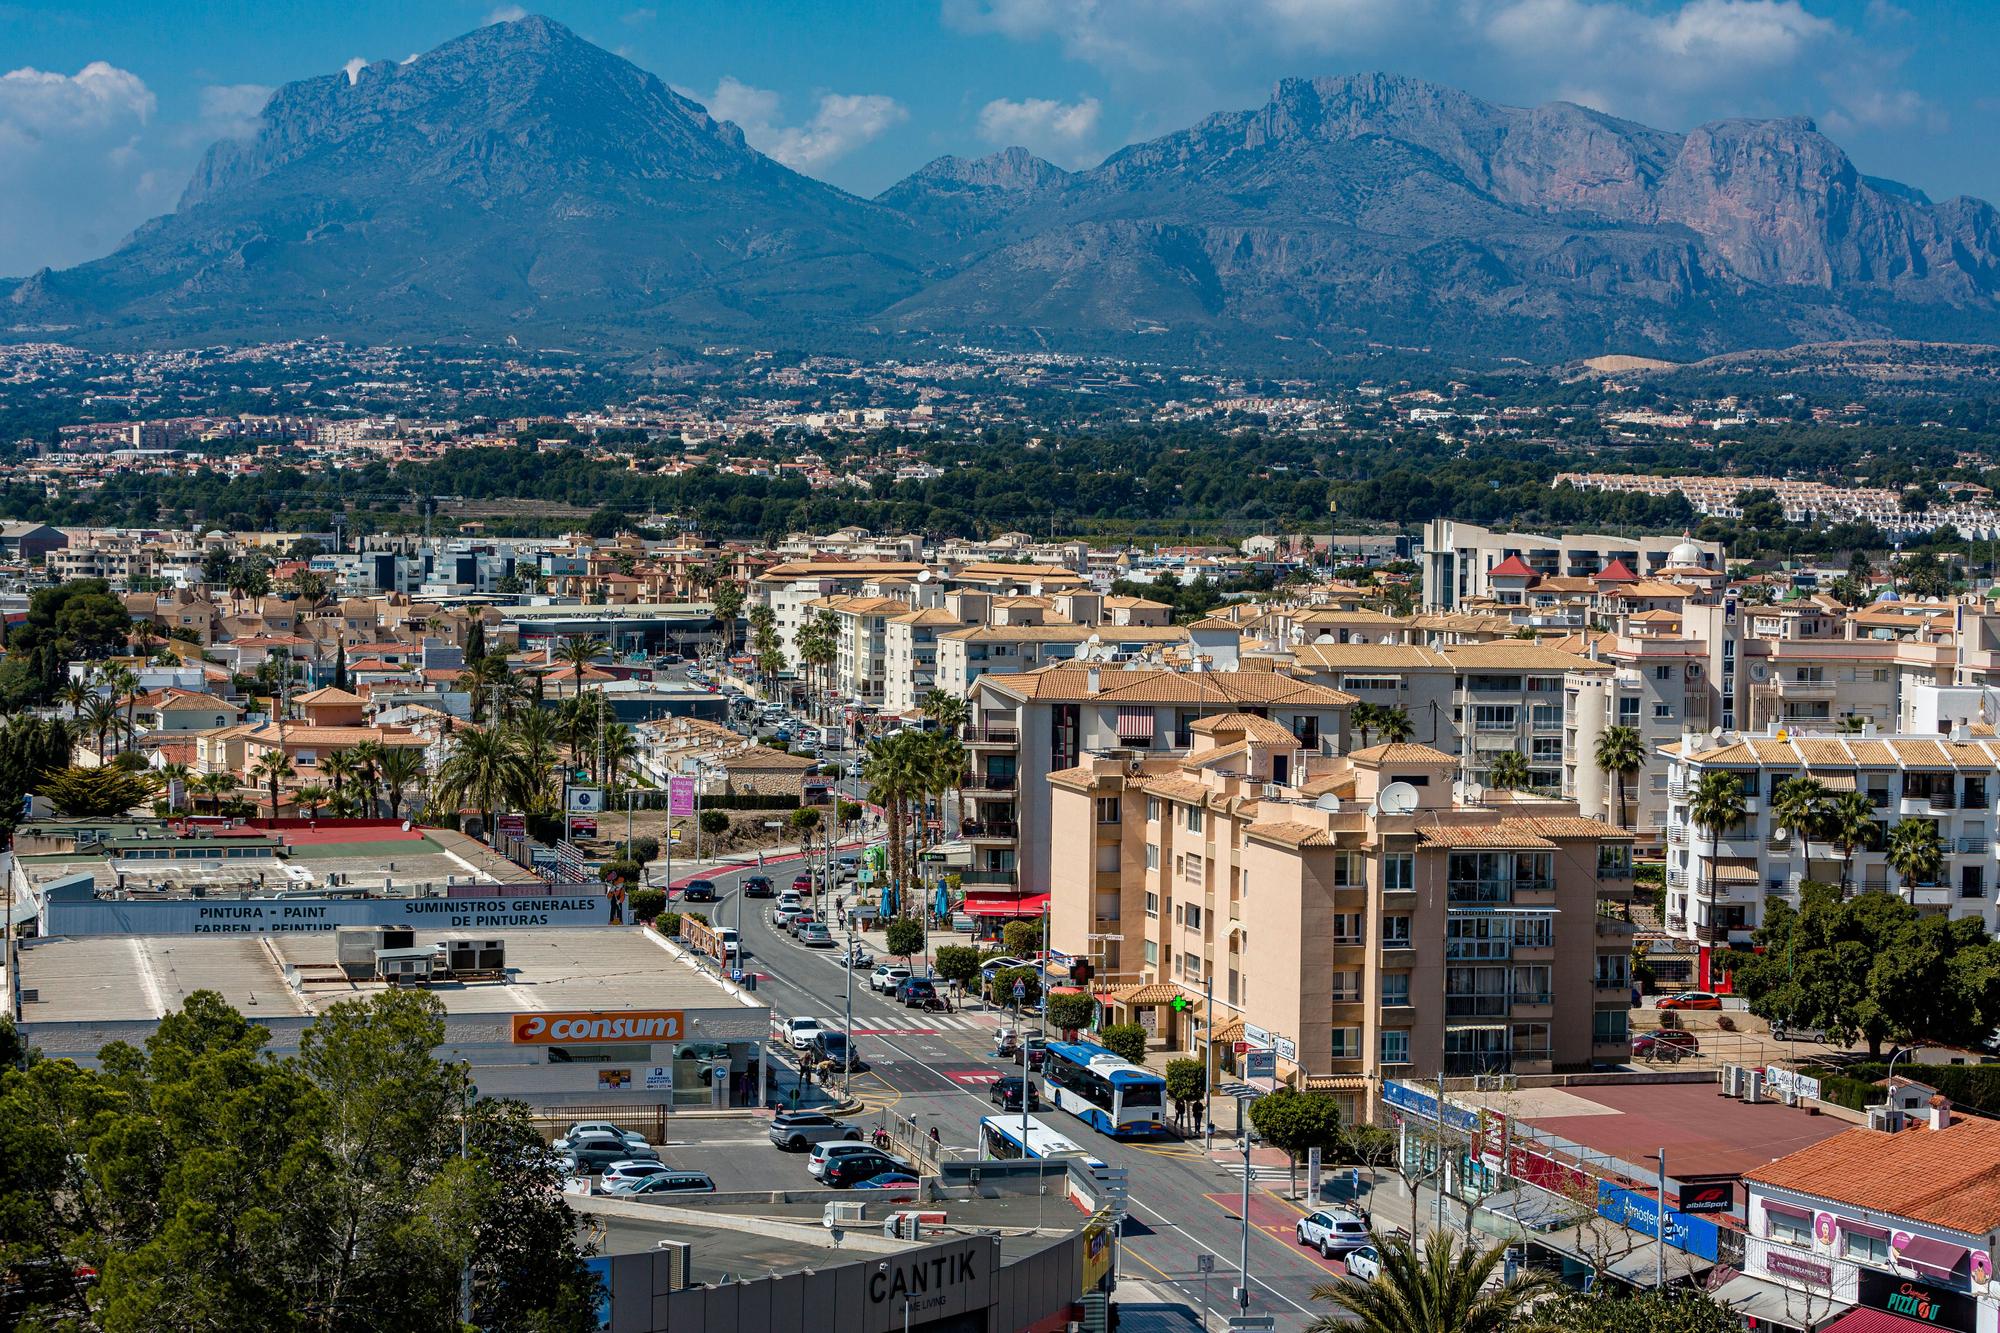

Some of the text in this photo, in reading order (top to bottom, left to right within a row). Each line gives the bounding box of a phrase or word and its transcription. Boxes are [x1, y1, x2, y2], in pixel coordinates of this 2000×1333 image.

[200, 907, 263, 918] PINTURA
[284, 907, 327, 918] PAINT
[405, 899, 595, 913] SUMINISTROS GENERALES
[451, 914, 548, 926] DE PINTURAS
[550, 1017, 679, 1040] consum
[869, 1250, 976, 1304] CANTIK
[922, 1296, 946, 1309] LIVING
